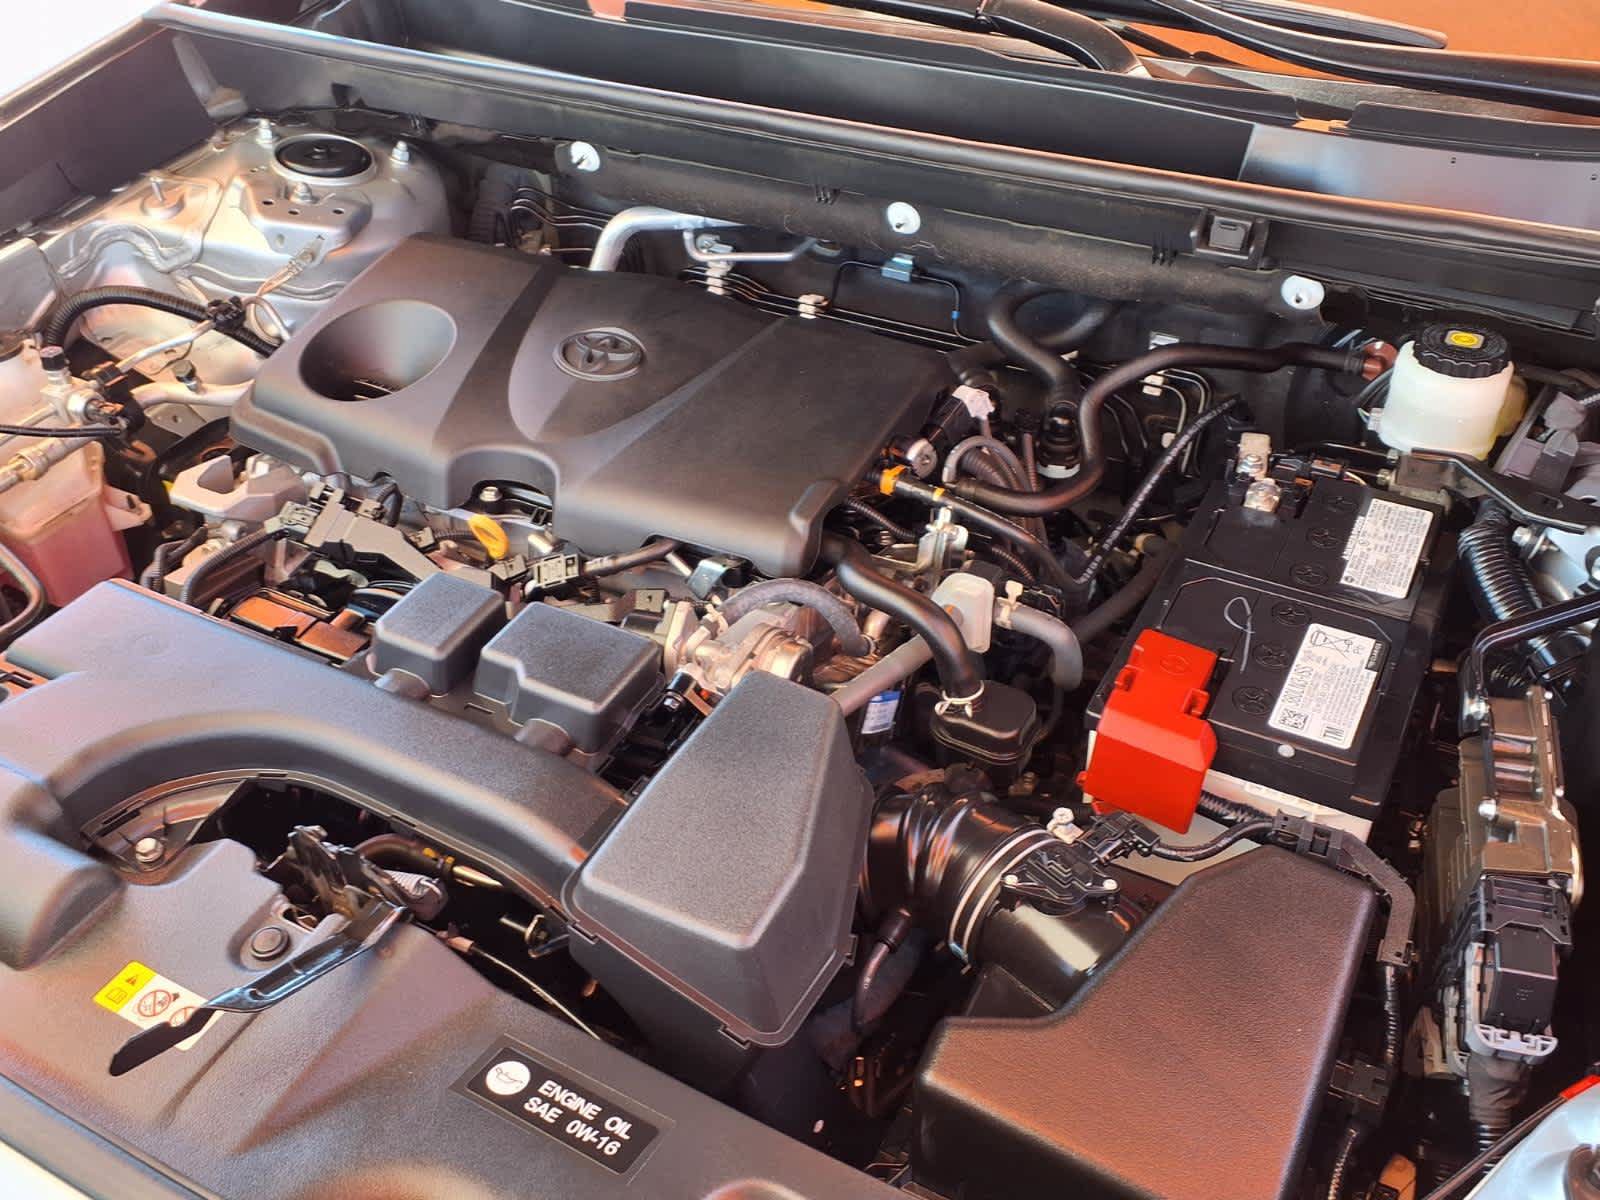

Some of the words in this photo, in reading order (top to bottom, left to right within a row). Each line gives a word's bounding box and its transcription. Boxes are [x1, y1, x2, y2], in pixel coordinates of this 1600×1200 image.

[523, 1097, 563, 1123] SAE
[565, 1119, 622, 1156] 0W-16
[537, 1079, 603, 1121] ENGINE
[604, 1116, 633, 1140] OIL
